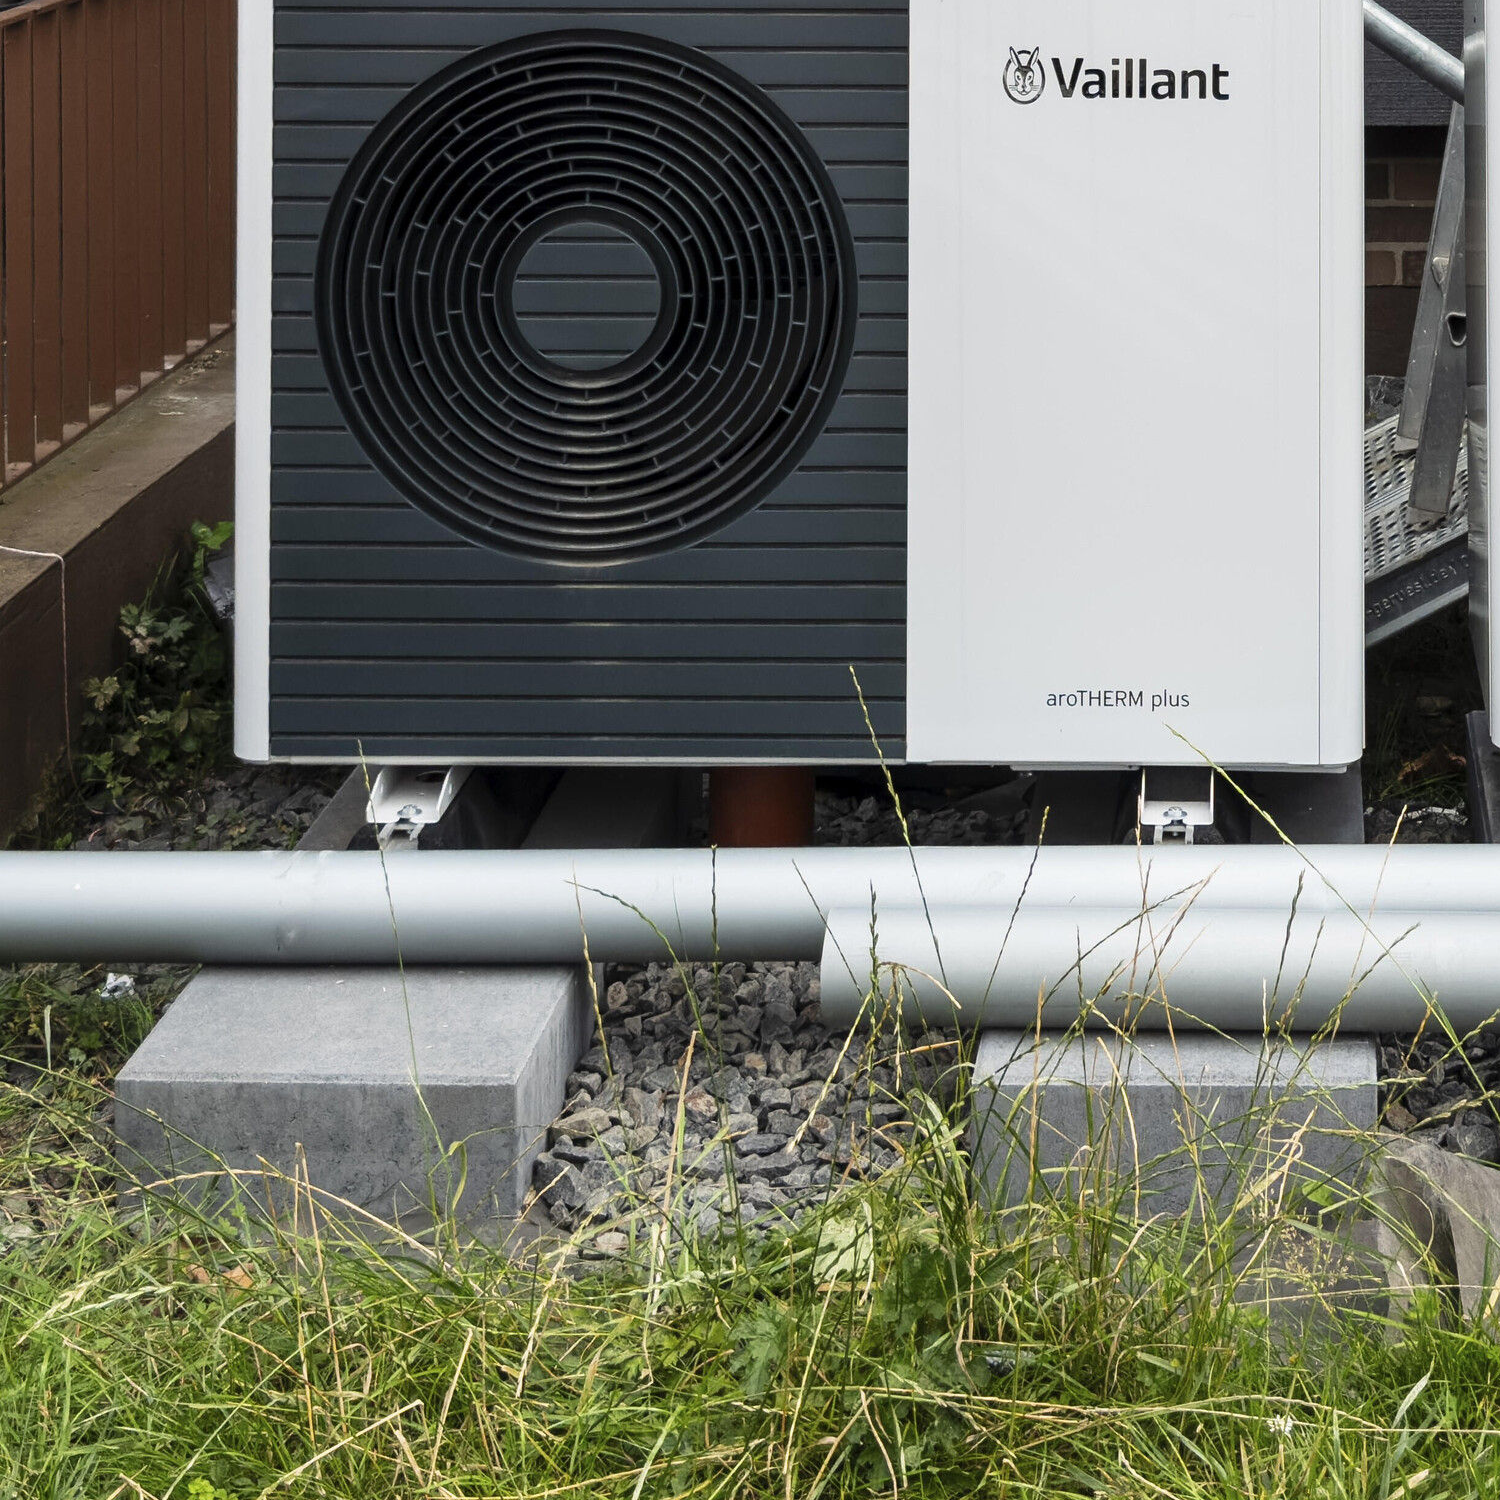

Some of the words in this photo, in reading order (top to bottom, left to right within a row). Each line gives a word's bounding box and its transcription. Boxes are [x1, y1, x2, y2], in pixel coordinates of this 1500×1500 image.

[1051, 57, 1230, 100] Vaillant
[1046, 690, 1143, 707] aroTHERM
[1152, 689, 1190, 712] plus
